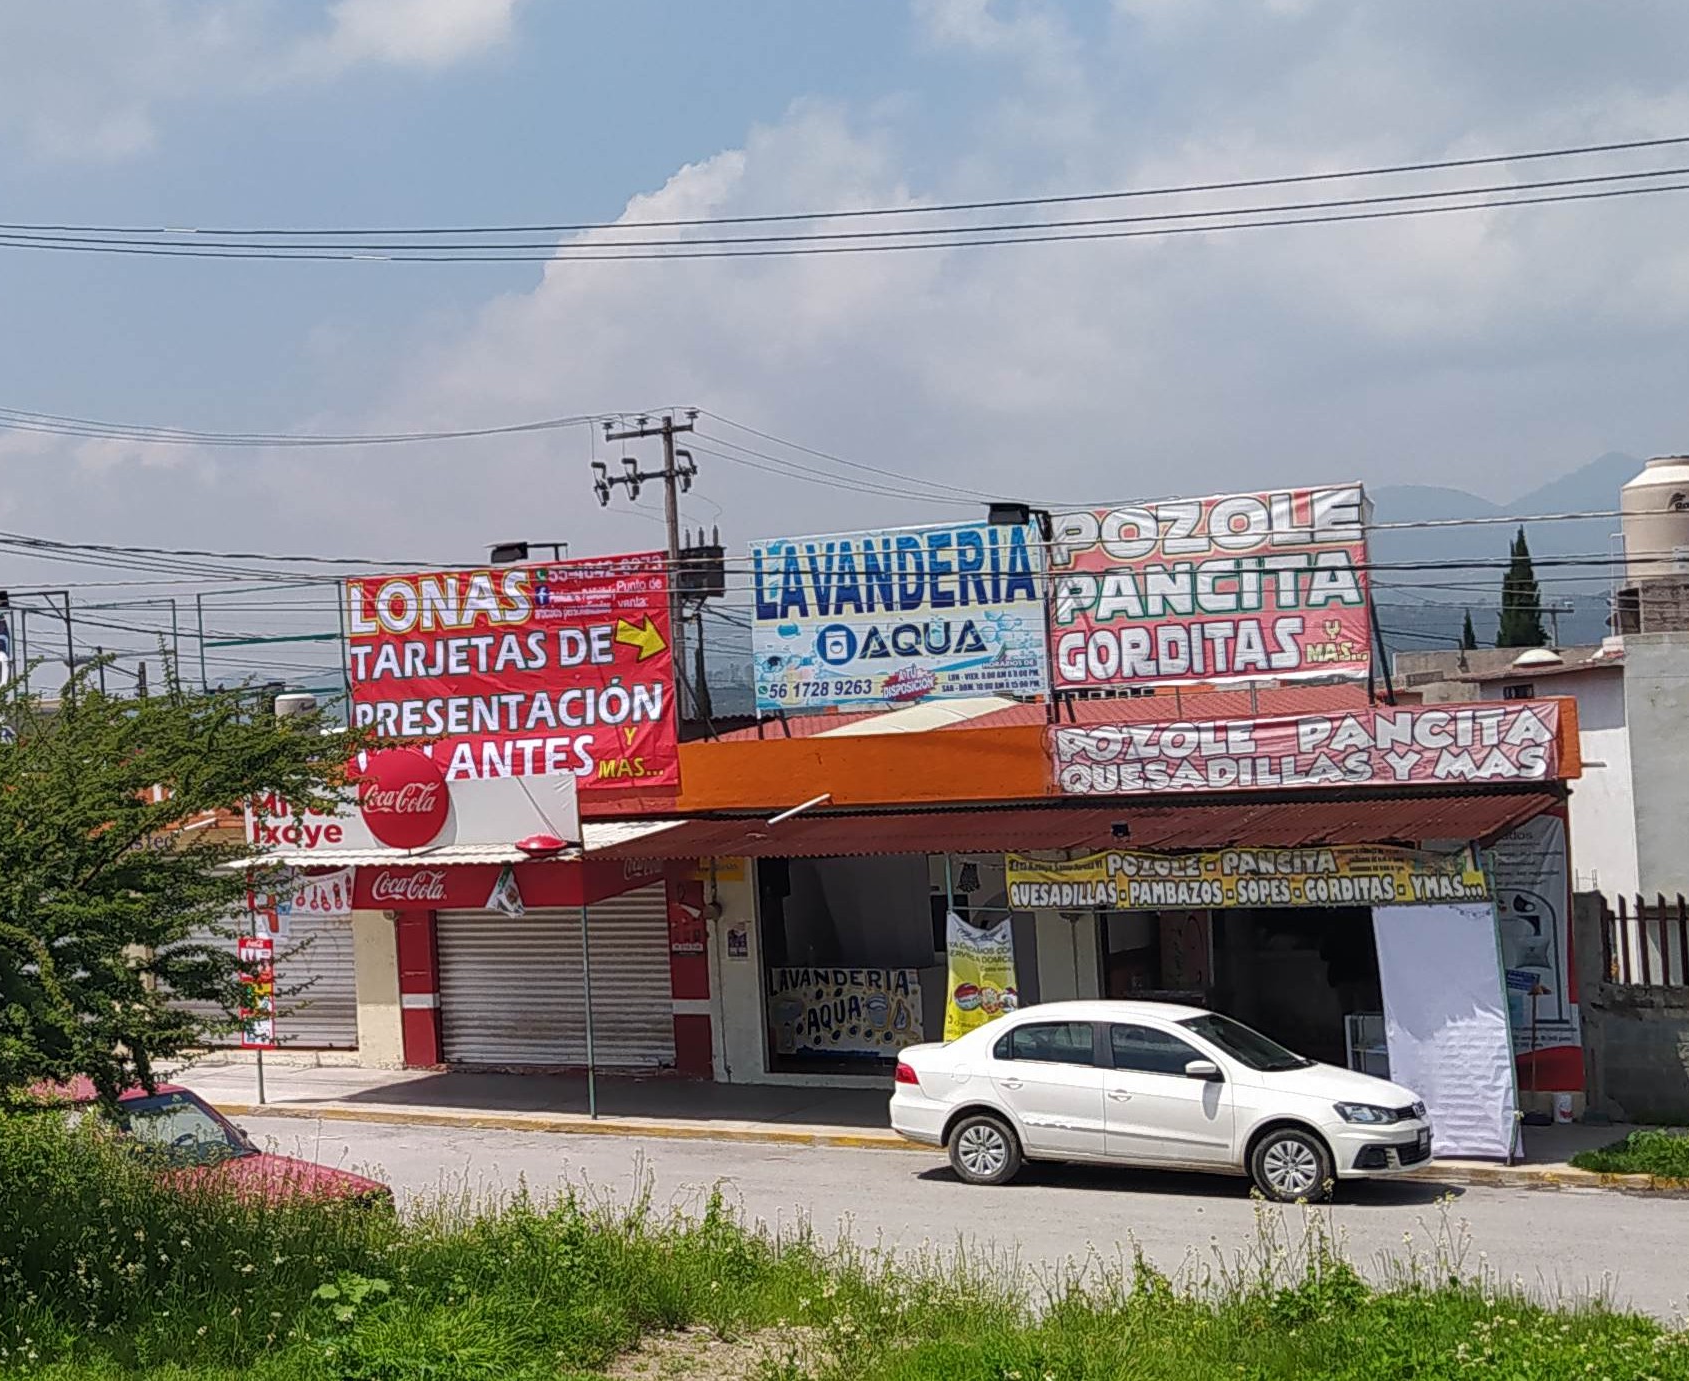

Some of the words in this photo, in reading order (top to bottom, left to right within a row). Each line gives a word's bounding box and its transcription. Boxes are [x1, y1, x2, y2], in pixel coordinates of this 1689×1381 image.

[1050, 487, 1362, 566] POZOLE
[649, 578, 663, 589] de
[753, 525, 1037, 620] LAVANDERIA
[1056, 549, 1364, 625] PANCITA
[347, 567, 533, 635] LONAS
[859, 619, 988, 660] AQUA
[1323, 619, 1341, 640] Y
[351, 631, 547, 681] TARJETAS
[559, 626, 614, 667] DE
[1057, 616, 1304, 682] GORDITAS
[768, 683, 788, 698] 56
[793, 680, 829, 697] 1728
[834, 678, 873, 696] 9263
[354, 677, 663, 739] PRESENTACIÓN
[623, 726, 638, 746] Y
[1056, 719, 1256, 763] POZOLE
[1297, 707, 1554, 754] PANCITA
[598, 757, 665, 779] MAS...
[1059, 750, 1375, 793] QUESADILLAS
[1384, 749, 1423, 781] Y
[1433, 745, 1548, 780] MAS
[363, 781, 441, 815] Coca-Cola
[252, 821, 343, 849] Ixoye
[1106, 852, 1201, 877] POZOLE
[1222, 849, 1340, 876] PANCITA
[372, 870, 447, 900] Coca-Cola
[1010, 878, 1117, 907] QUESADILLAS
[1128, 877, 1223, 907] PAMBAZOS
[1236, 876, 1291, 904] SOPES
[1304, 874, 1396, 902] GORDITAS
[769, 968, 909, 997] LAVANDERIA
[807, 995, 862, 1036] AQUA
